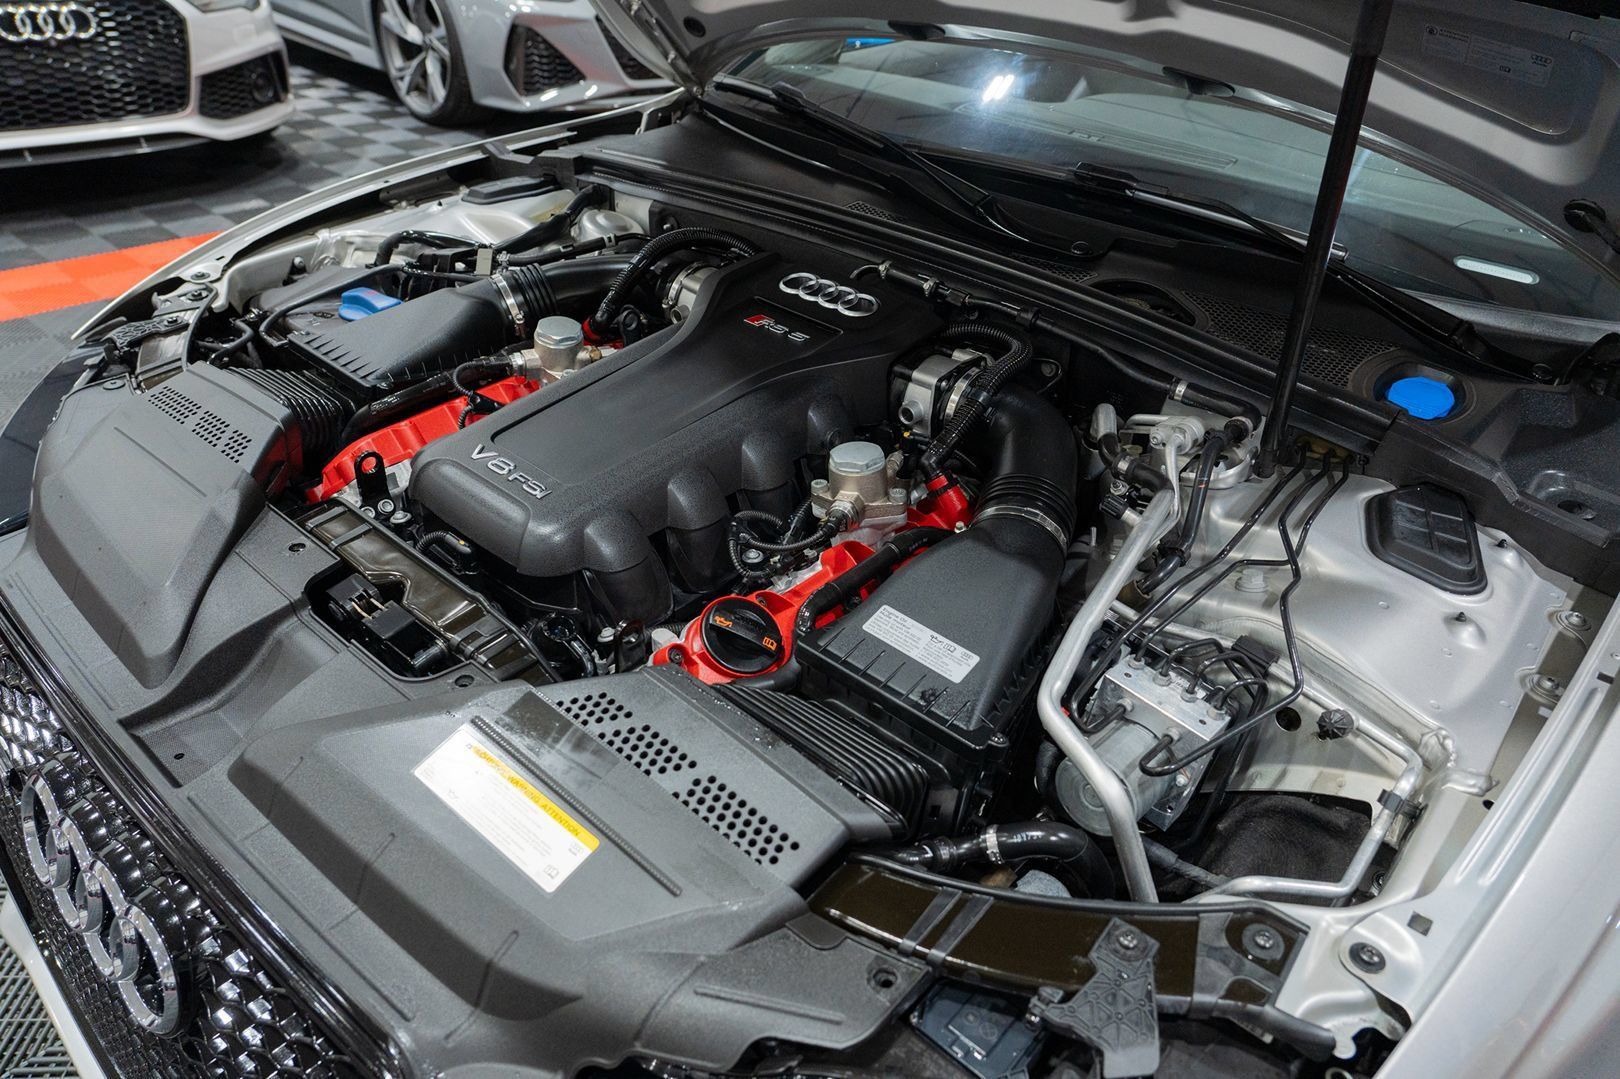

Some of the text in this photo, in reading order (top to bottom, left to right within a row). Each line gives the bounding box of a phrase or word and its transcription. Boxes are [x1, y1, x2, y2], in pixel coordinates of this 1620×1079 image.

[471, 443, 552, 499] V8 FSI
[541, 803, 580, 836] ATTENTION
